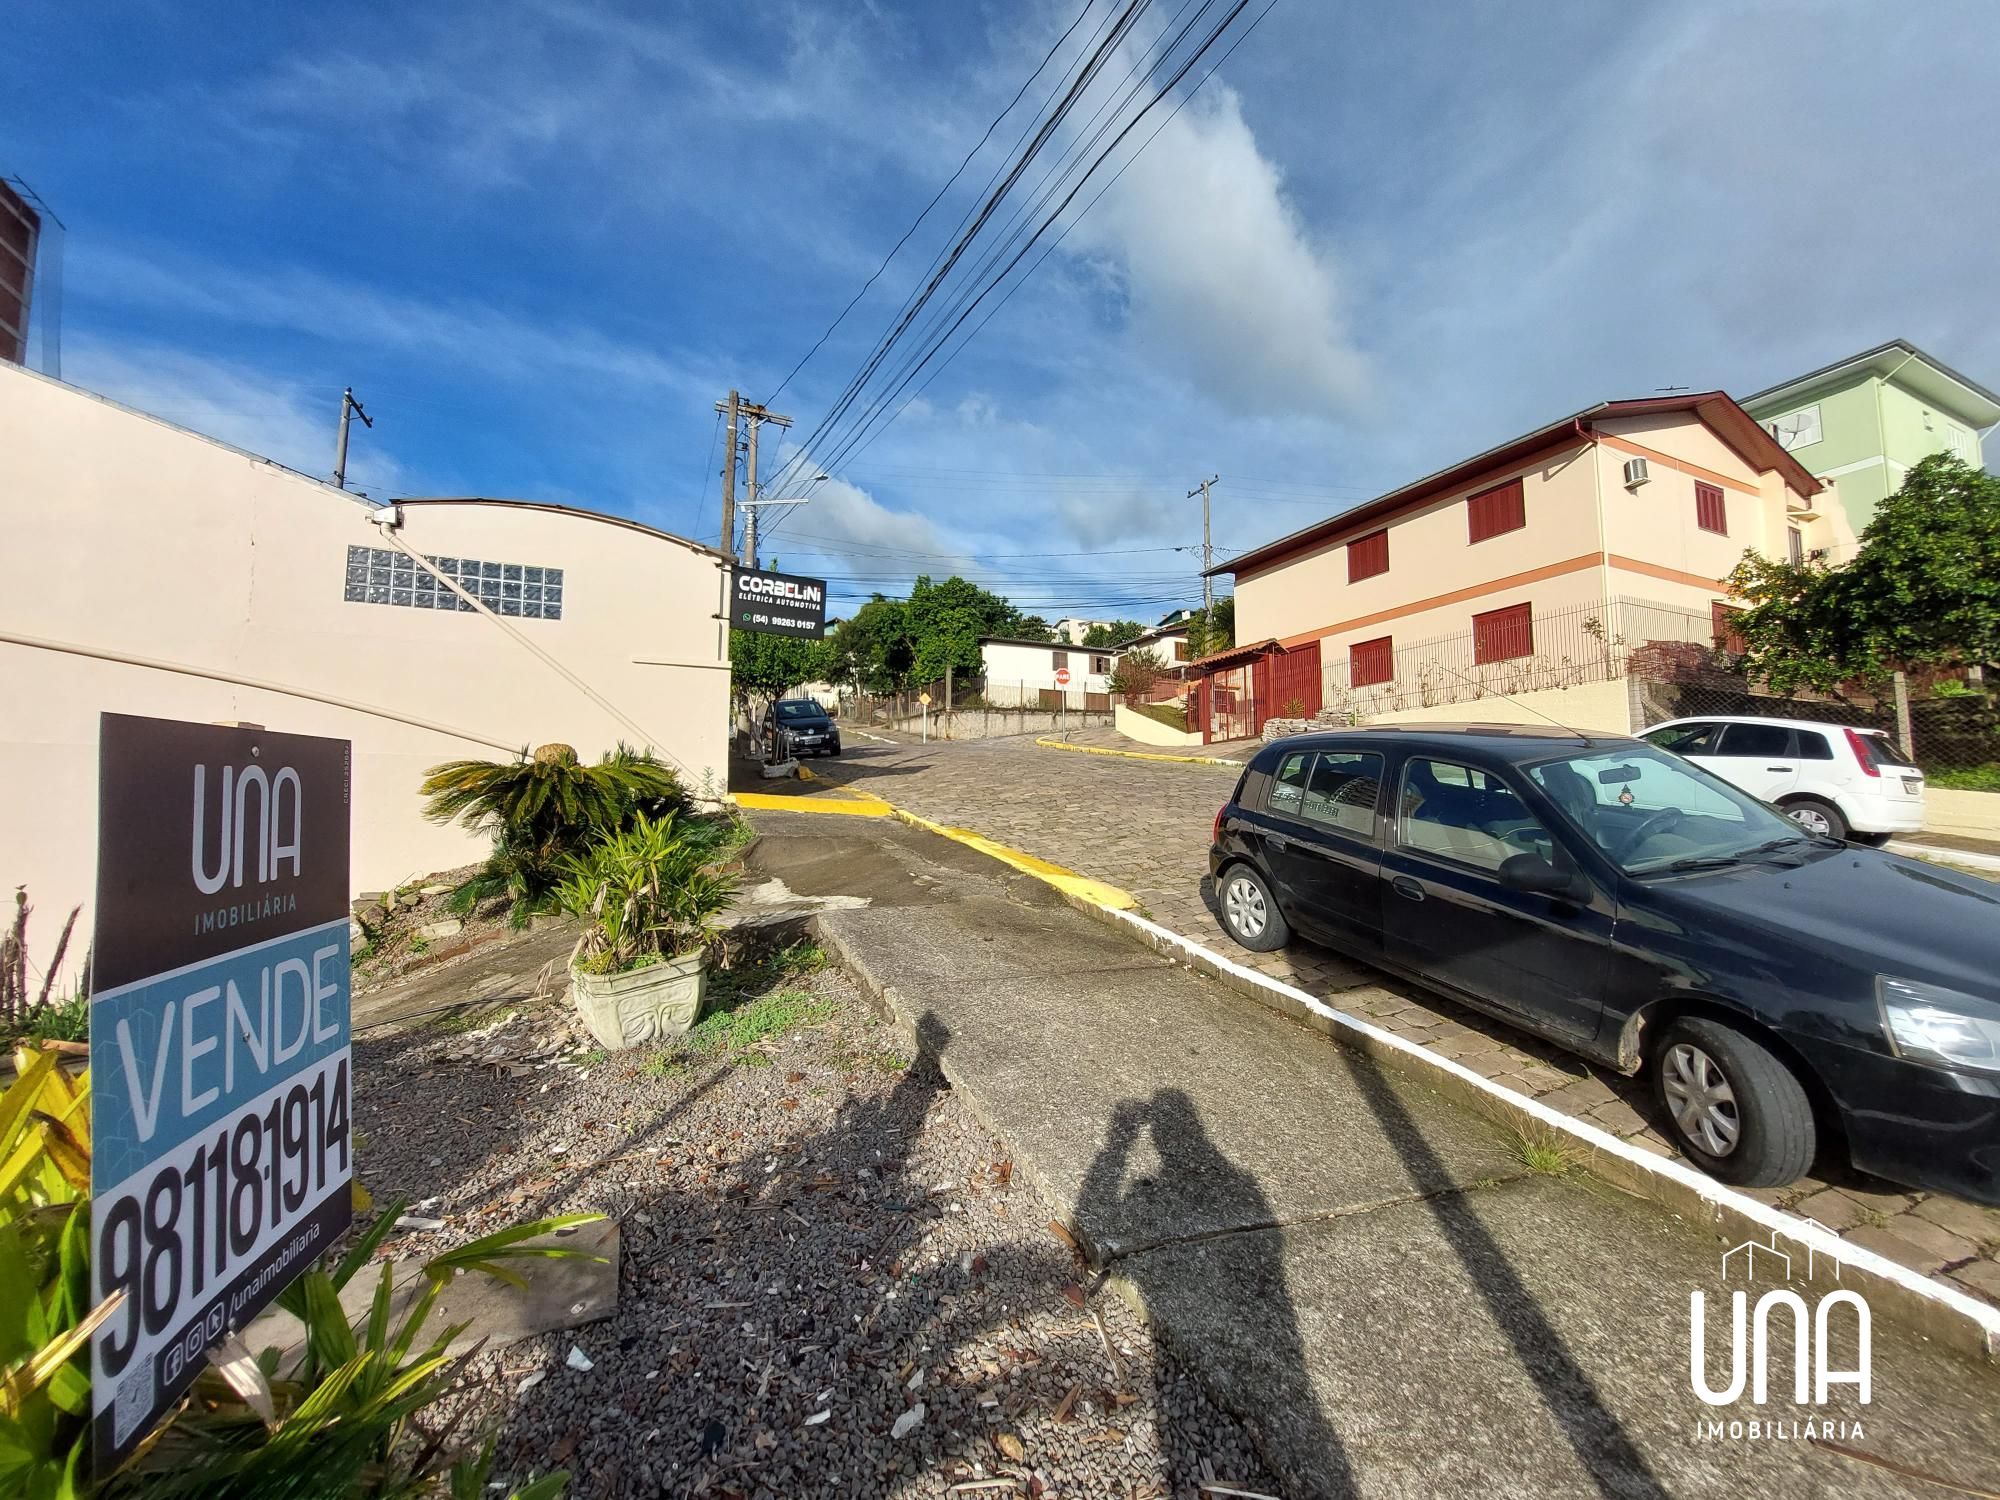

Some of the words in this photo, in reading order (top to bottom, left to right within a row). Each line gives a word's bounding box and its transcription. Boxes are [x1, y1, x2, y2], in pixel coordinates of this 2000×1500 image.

[738, 592, 773, 604] ELÉTRICA
[775, 598, 821, 611] AUTOMOTIVA
[752, 614, 768, 625] (54)
[796, 620, 816, 630] 0157
[192, 764, 301, 895] UNA
[194, 893, 297, 936] IMOBILIÁRIA
[116, 943, 340, 1143] VENDE
[228, 1222, 320, 1320] /unaimobiliaria
